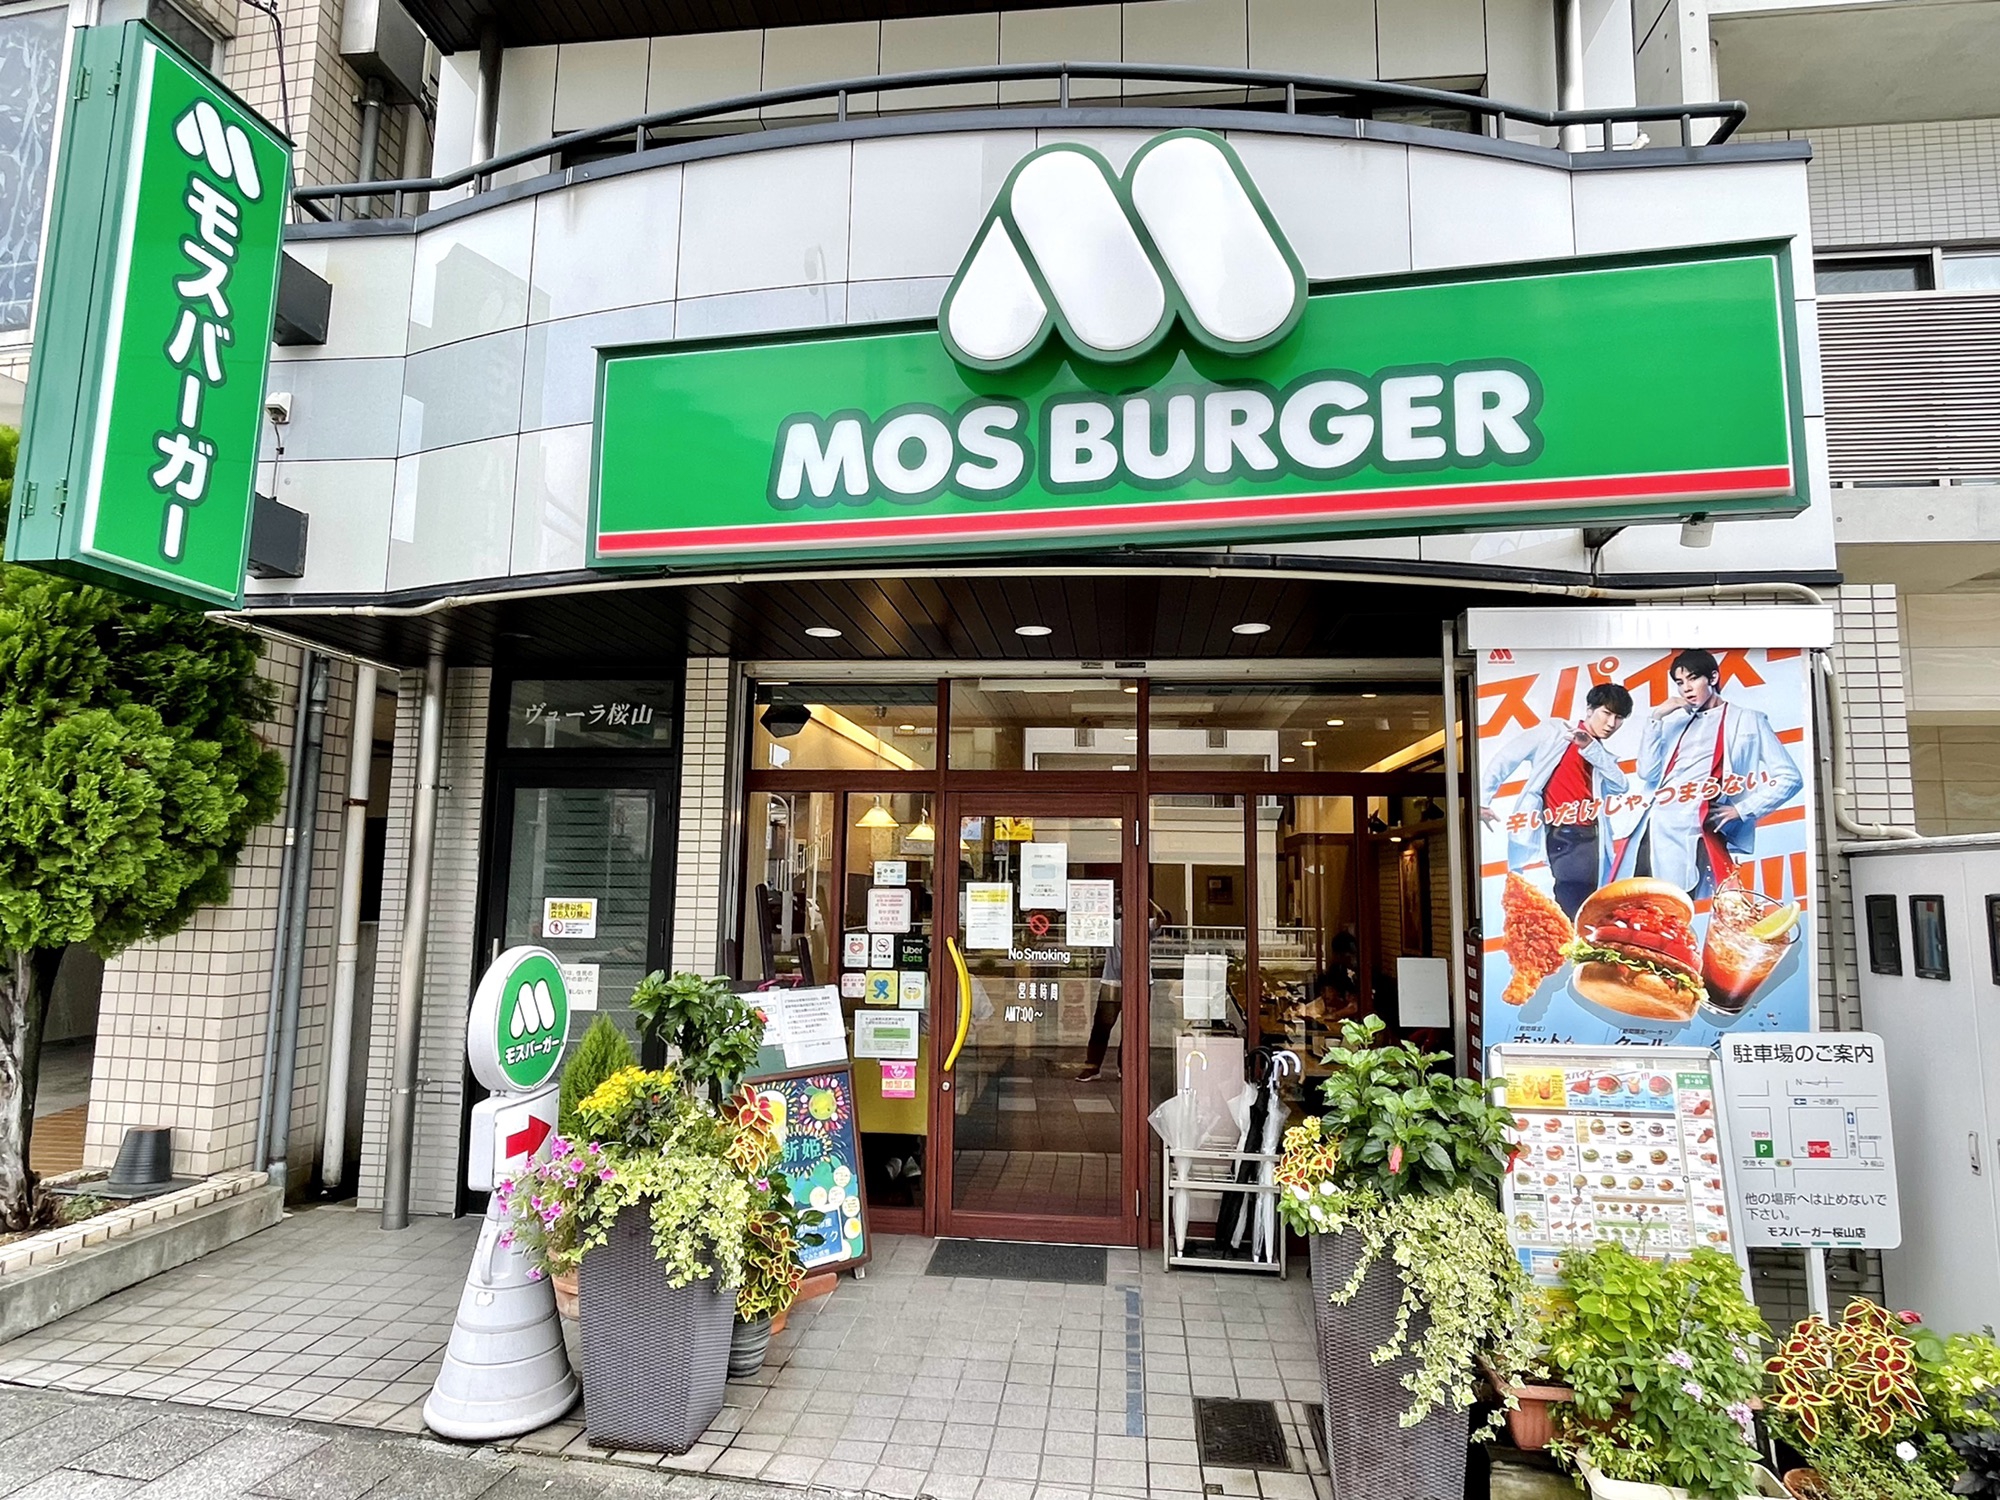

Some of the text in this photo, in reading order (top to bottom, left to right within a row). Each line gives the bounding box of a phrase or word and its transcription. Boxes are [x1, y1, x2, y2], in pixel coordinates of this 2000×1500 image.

[156, 176, 239, 559] モスバーガー
[779, 368, 1532, 500] MOS BURGER
[1506, 770, 1778, 834] 辛いだけじゃ、つまらない。
[902, 945, 923, 954] Uber
[1008, 948, 1071, 963] No Smoking
[902, 955, 923, 963] Eats
[1018, 982, 1059, 1001] 営業時間
[505, 1035, 560, 1065] モスバーガー
[1733, 1043, 1874, 1064] 駐車場のご案内
[1795, 1078, 1803, 1086] N
[1759, 1144, 1768, 1153] P
[1745, 1192, 1887, 1207] 他の場所へは止めないで
[1746, 1208, 1790, 1221] 下さい。
[1767, 1227, 1866, 1239] モスバーガー桜山店
